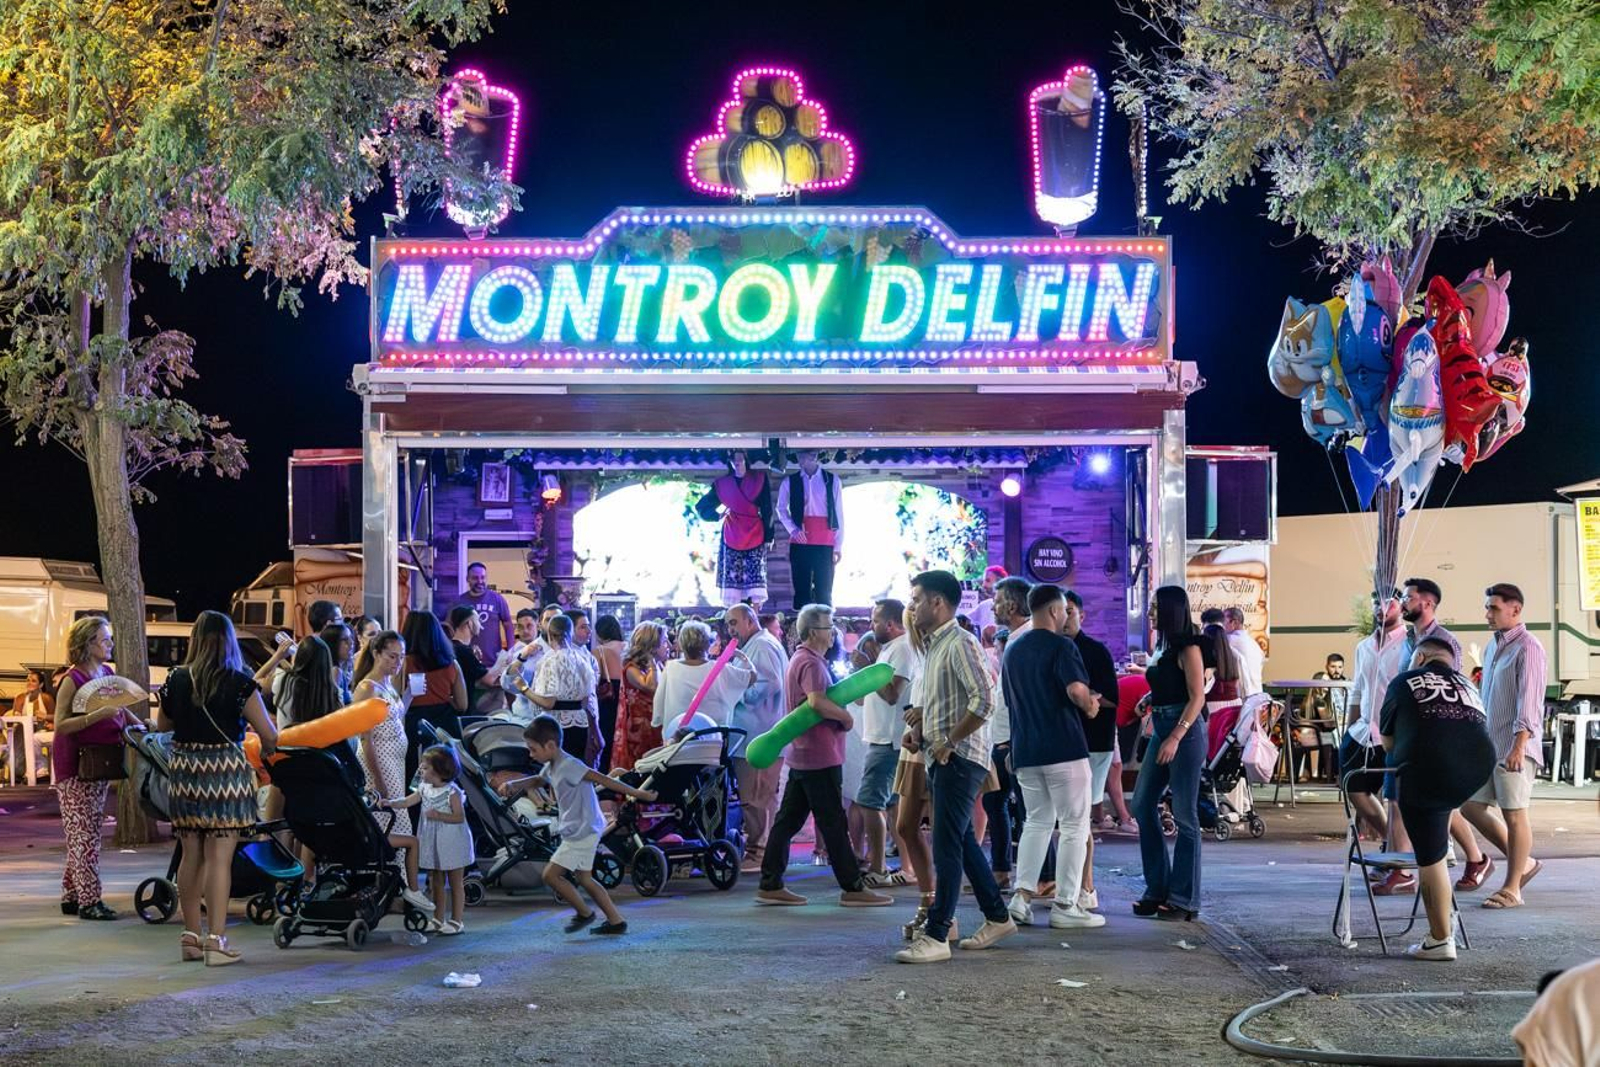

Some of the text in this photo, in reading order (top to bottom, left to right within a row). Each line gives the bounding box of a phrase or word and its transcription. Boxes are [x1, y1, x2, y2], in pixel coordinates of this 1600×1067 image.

[382, 263, 1155, 343] MONTROY DELFIN
[1038, 549, 1063, 558] HAY VINO
[1034, 559, 1067, 568] SIN ALCOHOL
[305, 581, 356, 598] Montroy
[1187, 582, 1213, 597] ntroy
